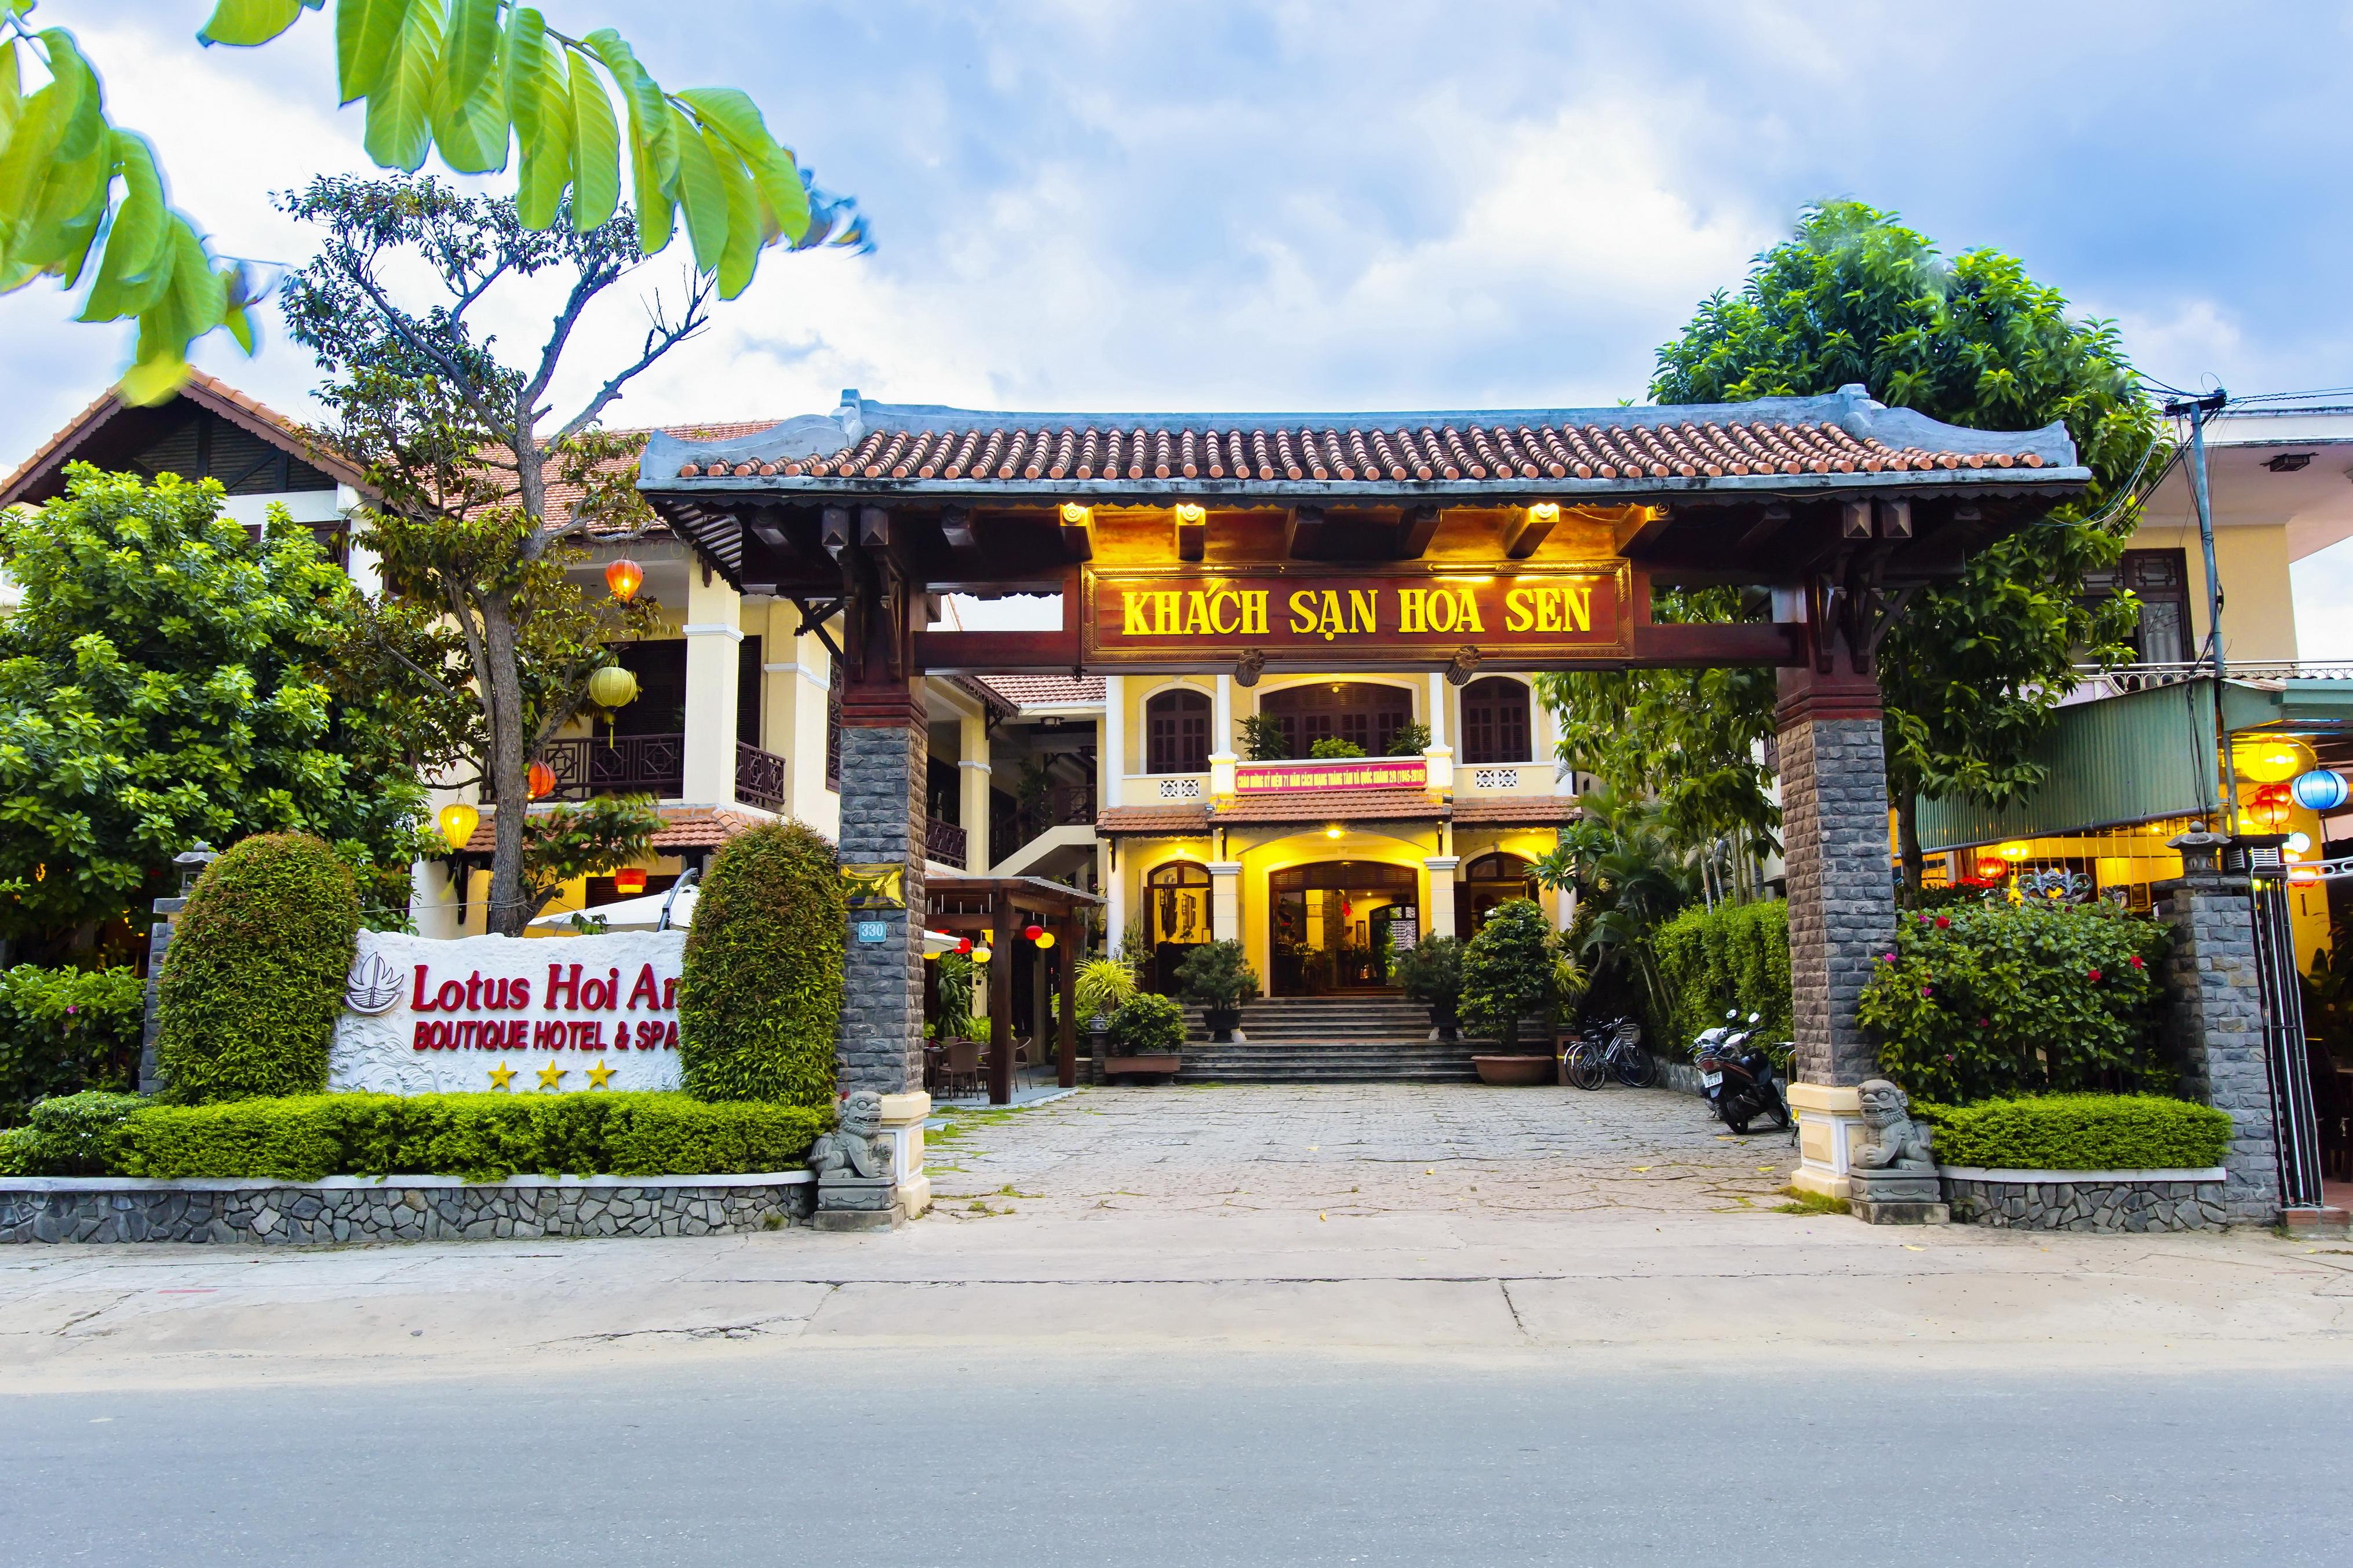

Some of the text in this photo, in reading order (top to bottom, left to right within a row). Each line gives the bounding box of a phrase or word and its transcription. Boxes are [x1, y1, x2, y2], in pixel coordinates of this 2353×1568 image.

[1121, 580, 1592, 641] KHÁCH SẠN HOA SEN
[1237, 772, 1250, 788] CHÀO
[1283, 775, 1289, 787] 71
[1301, 771, 1313, 786] CÁCH
[1328, 770, 1343, 786] THÁNG
[1353, 769, 1360, 785] VÀ
[1373, 768, 1389, 783] KHÁNH
[861, 924, 883, 937] 330
[410, 964, 530, 1012] Lotus
[544, 963, 619, 1011] Hoi
[413, 1020, 680, 1051] BOUTIQUE HOTEL & SPA
